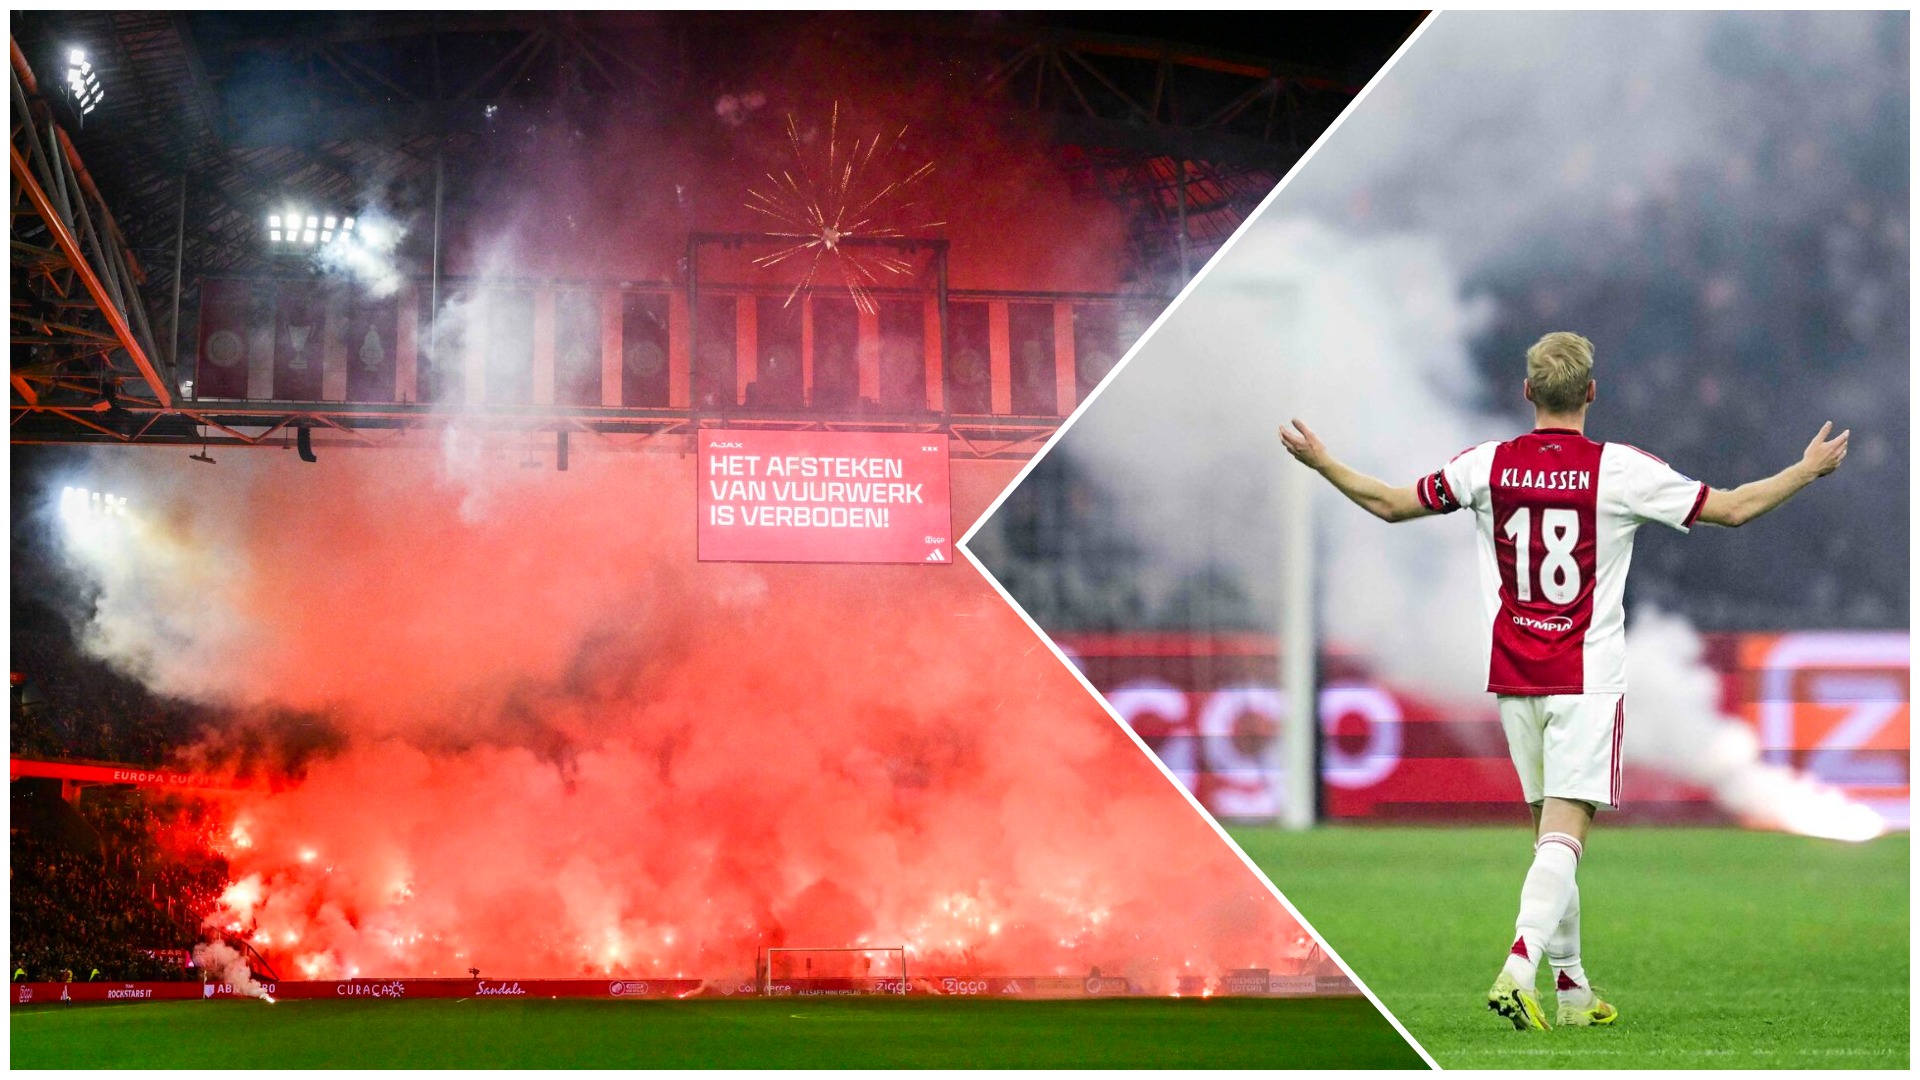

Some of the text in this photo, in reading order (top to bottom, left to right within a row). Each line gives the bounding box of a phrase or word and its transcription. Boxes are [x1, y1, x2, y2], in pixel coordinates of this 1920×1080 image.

[710, 455, 903, 478] HET AFSTEKEN
[1500, 468, 1590, 490] KLAASSEN
[710, 480, 923, 504] VAN VUURWERK
[710, 505, 889, 528] IS VERBODEN!
[1503, 507, 1581, 606] 18
[1512, 616, 1573, 632] OLYMPIA
[113, 770, 164, 783] EUROPA
[169, 774, 196, 785] CUP
[107, 989, 152, 998] ROCKSTARS IT
[475, 980, 526, 996] Sandals
